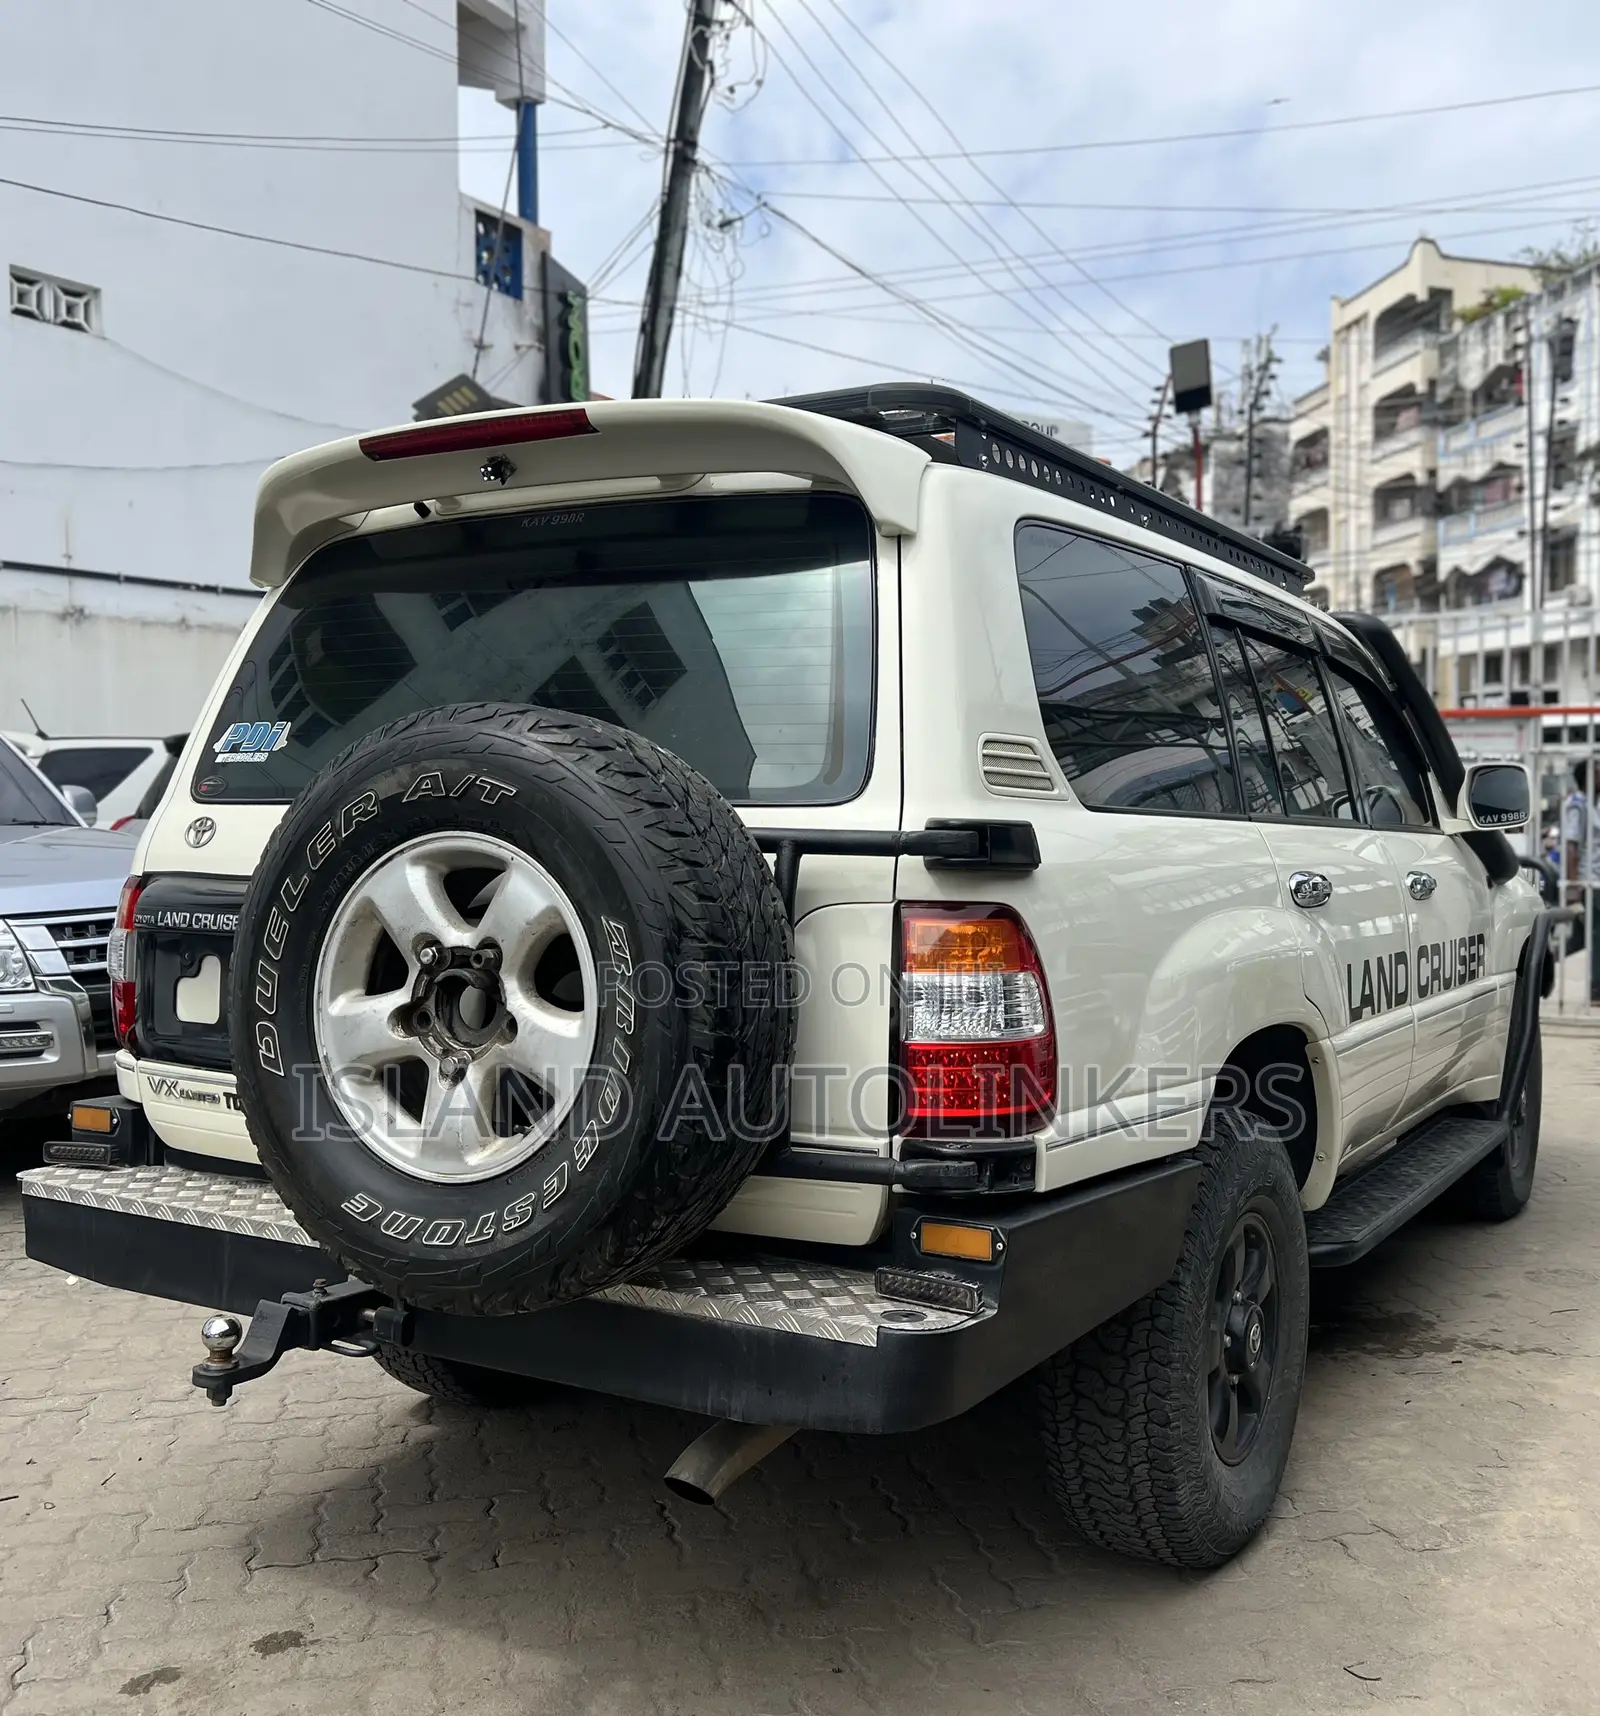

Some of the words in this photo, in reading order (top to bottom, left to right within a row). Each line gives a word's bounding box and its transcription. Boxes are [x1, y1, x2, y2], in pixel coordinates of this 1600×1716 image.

[521, 516, 550, 528] KAV
[1479, 813, 1499, 824] KAV
[1500, 811, 1528, 822] 998R
[157, 911, 190, 928] LAND
[192, 912, 239, 930] CRUISE
[255, 790, 379, 1077] DUELER
[402, 771, 518, 805] A/T
[1347, 951, 1409, 1024] LAND
[1417, 933, 1486, 999] CRUISER
[147, 1076, 180, 1099] VX
[341, 916, 636, 1246] BRIDGESTONE
